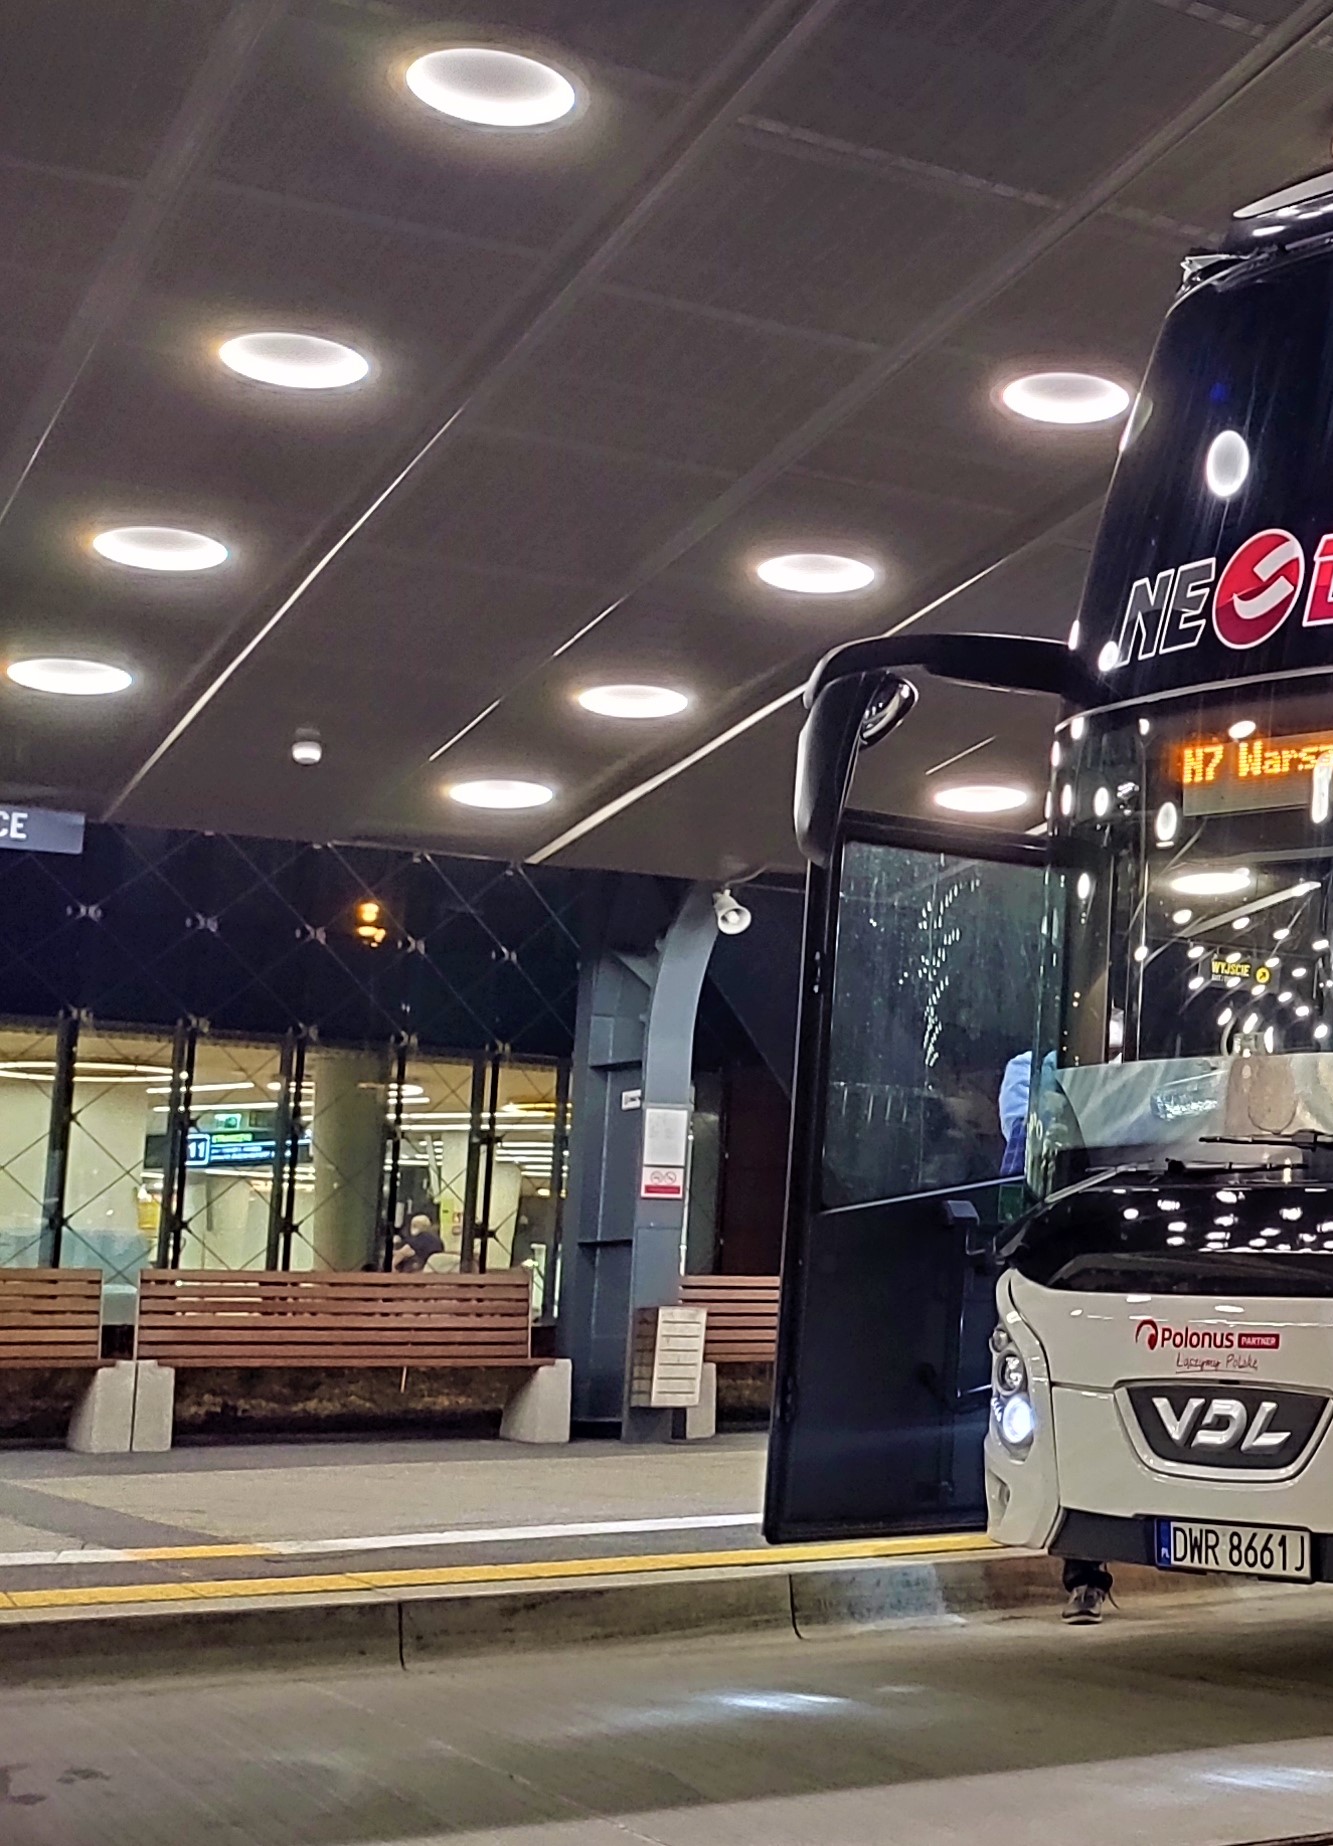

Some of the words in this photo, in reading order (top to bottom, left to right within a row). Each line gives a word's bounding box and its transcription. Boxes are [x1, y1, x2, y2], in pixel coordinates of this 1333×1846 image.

[1160, 1325, 1235, 1349] Polonus
[1240, 1336, 1277, 1347] PARTNER
[1152, 1396, 1292, 1452] VDL
[1172, 1526, 1221, 1567] DWR
[1227, 1531, 1307, 1574] 8661J
